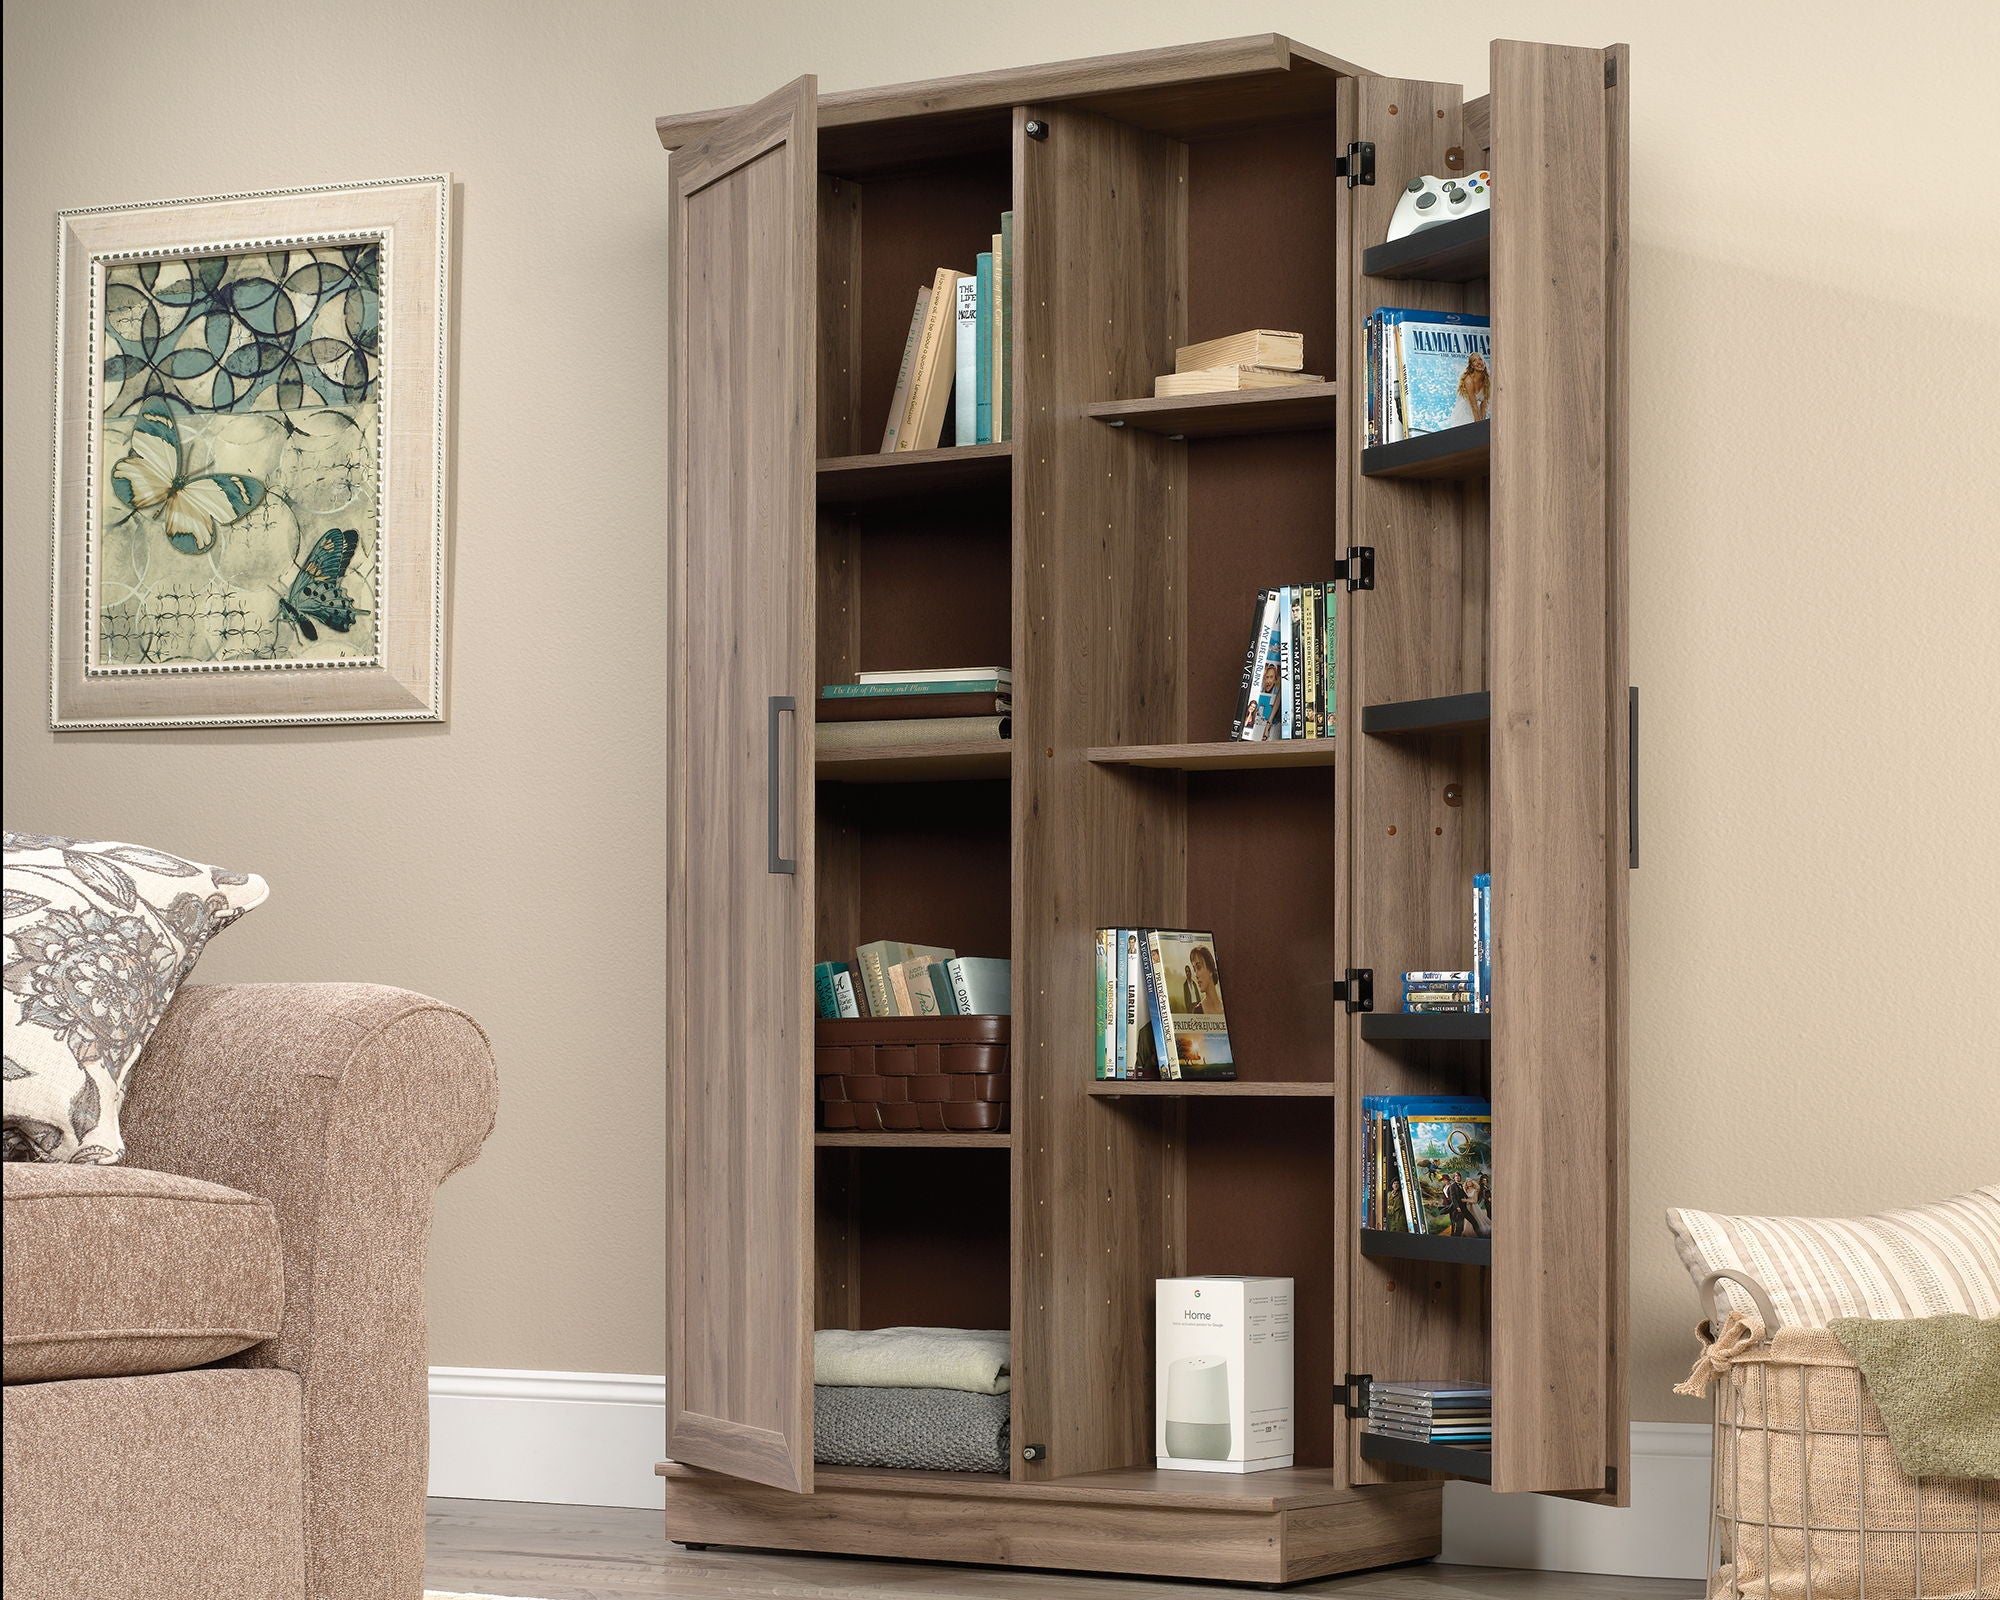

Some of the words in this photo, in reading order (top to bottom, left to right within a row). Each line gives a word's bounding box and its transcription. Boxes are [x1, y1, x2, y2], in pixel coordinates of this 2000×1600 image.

[959, 285, 973, 293] THE
[961, 294, 976, 302] LIFE
[913, 300, 922, 320] THE
[927, 323, 934, 331] be
[923, 331, 932, 349] about
[1412, 330, 1461, 353] MAMMA
[896, 327, 916, 390] PRINCIPAL
[1261, 625, 1271, 639] MY
[1258, 640, 1268, 654] LIFE
[1257, 655, 1264, 663] IN
[1293, 651, 1301, 680] MAZE
[1240, 650, 1256, 689] GIVER
[1252, 663, 1263, 687] RUINS
[1293, 683, 1302, 727] RUNNER
[1140, 940, 1149, 970] AUGUST
[836, 976, 844, 991] A
[953, 964, 963, 984] THE
[1184, 1309, 1211, 1320] Home
